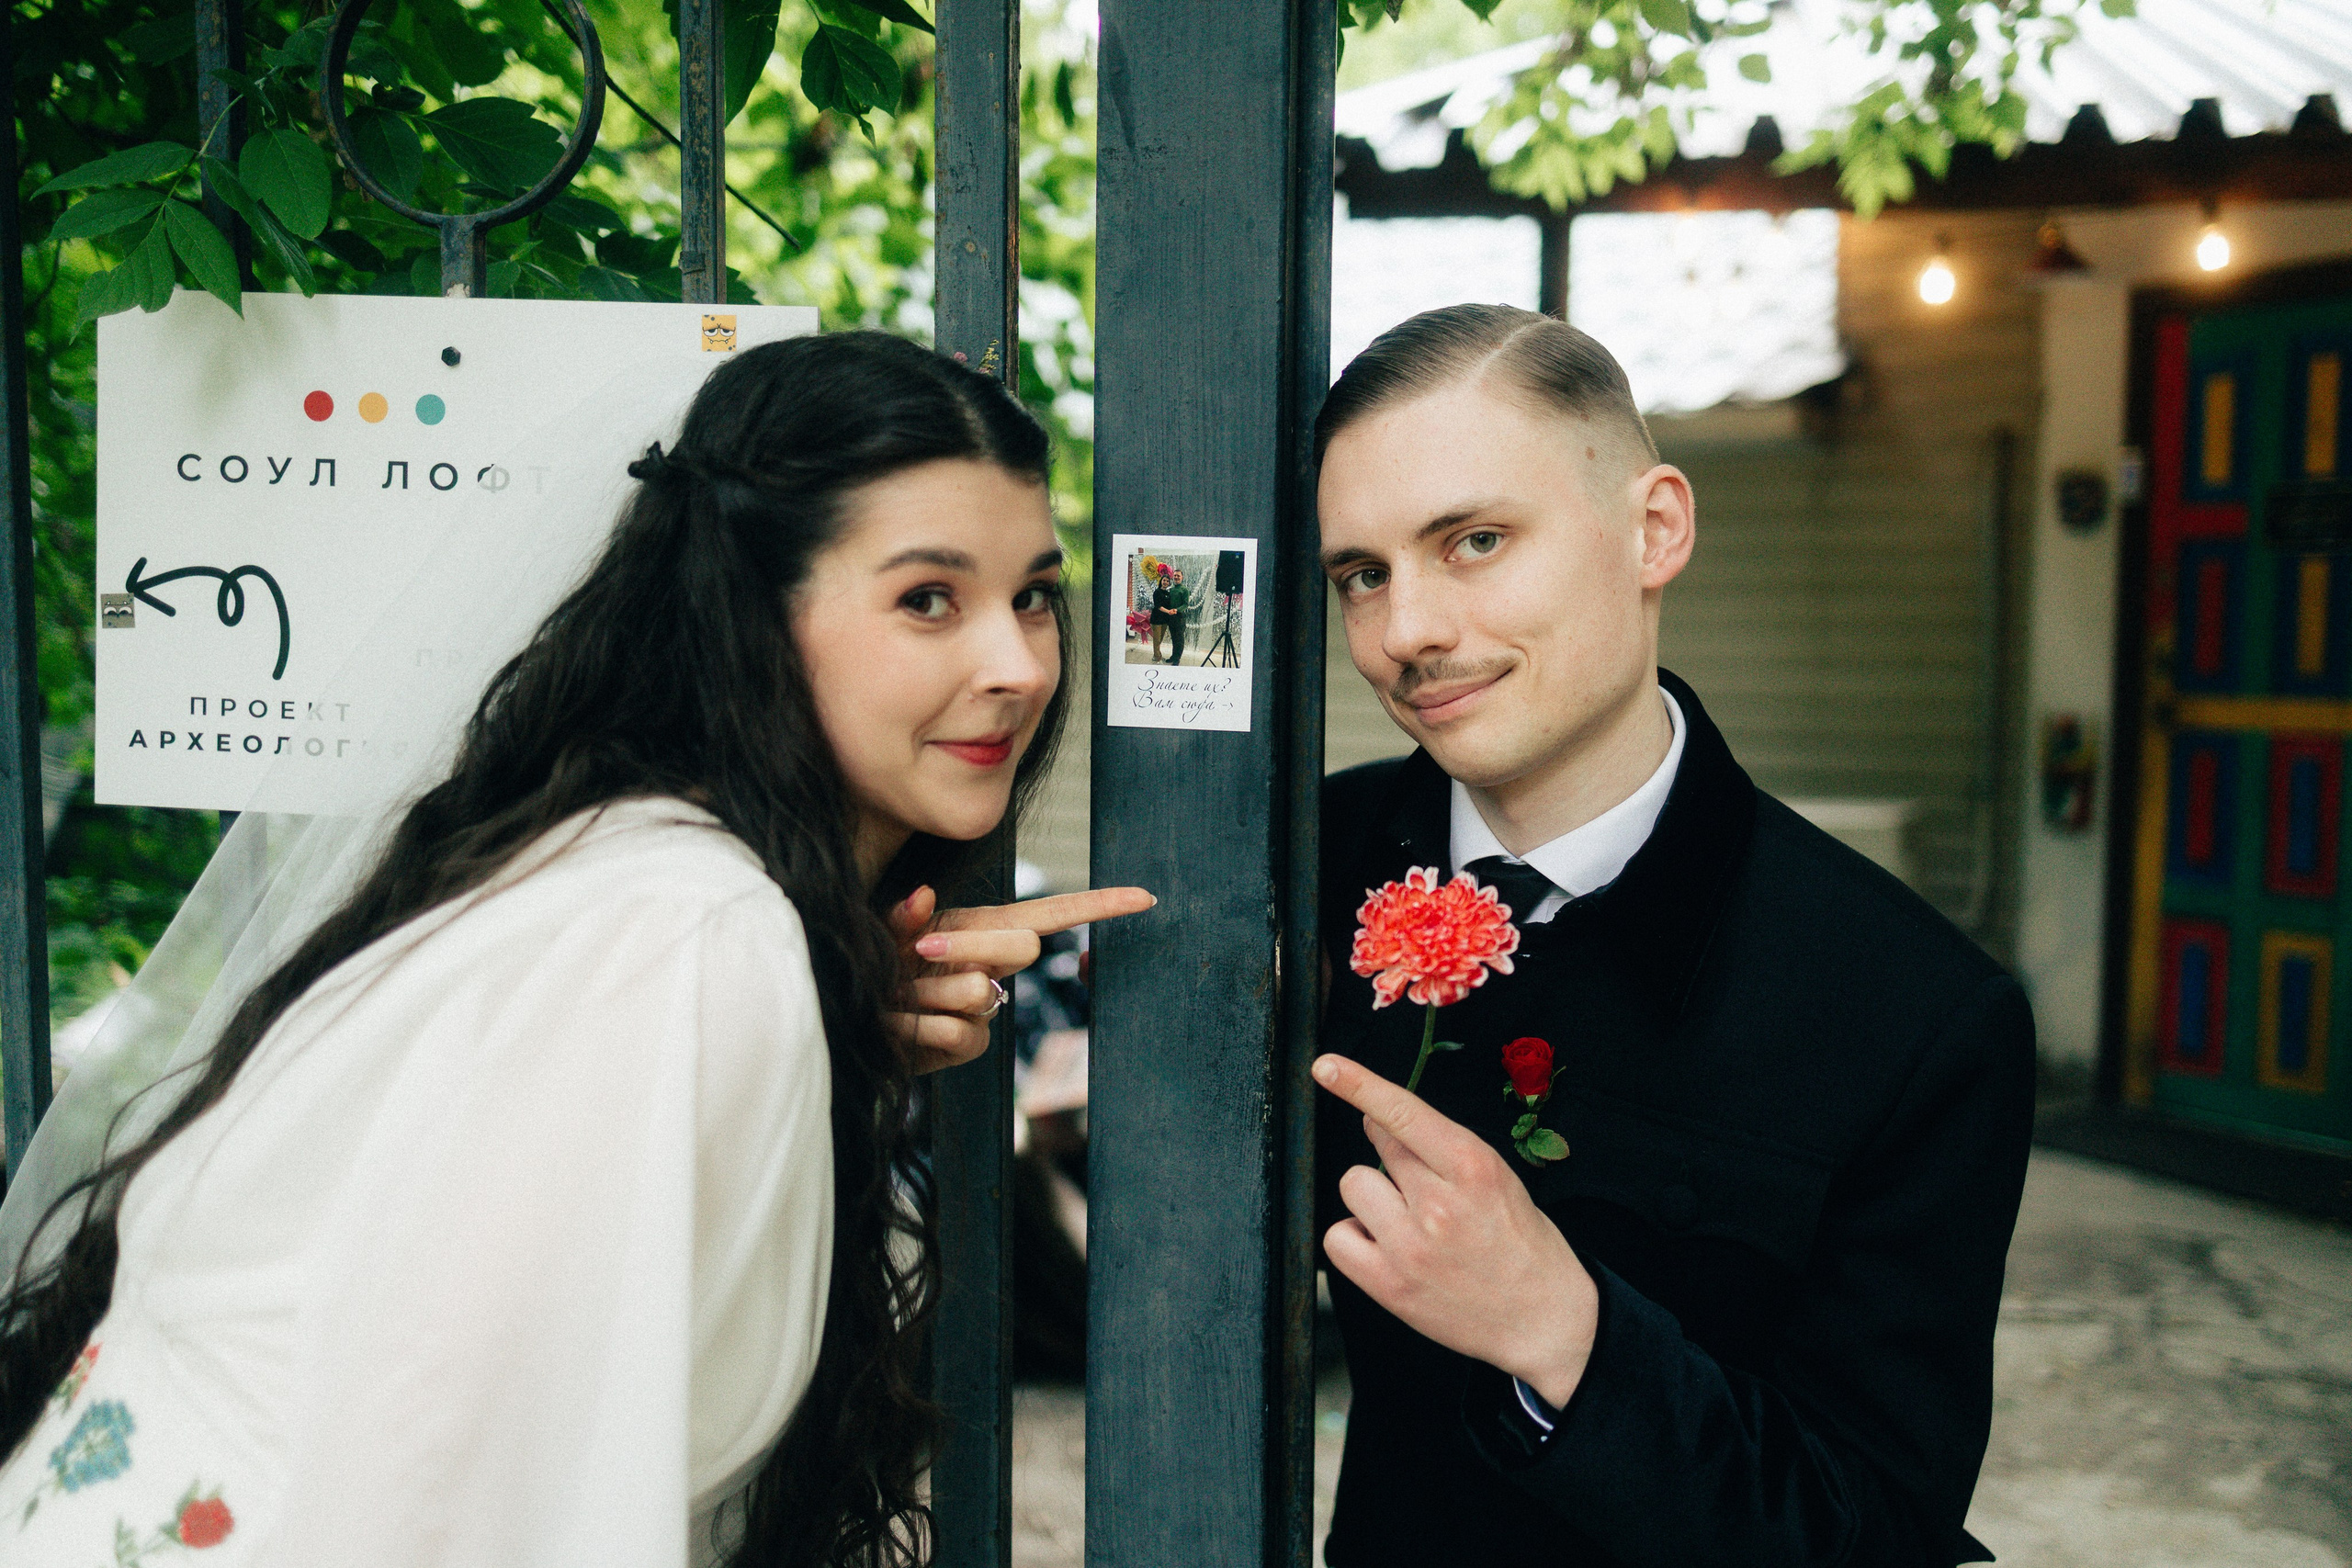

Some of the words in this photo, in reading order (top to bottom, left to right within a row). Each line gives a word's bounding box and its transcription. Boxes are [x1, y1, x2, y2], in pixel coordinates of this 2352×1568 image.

[176, 453, 337, 488] СОУЛ
[1137, 669, 1198, 692] Знаете
[189, 696, 351, 722] ПРОЕКТ
[1132, 690, 1174, 708] Вам
[1181, 698, 1216, 723] сюда
[128, 728, 408, 758] АРХЕОЛОГ
